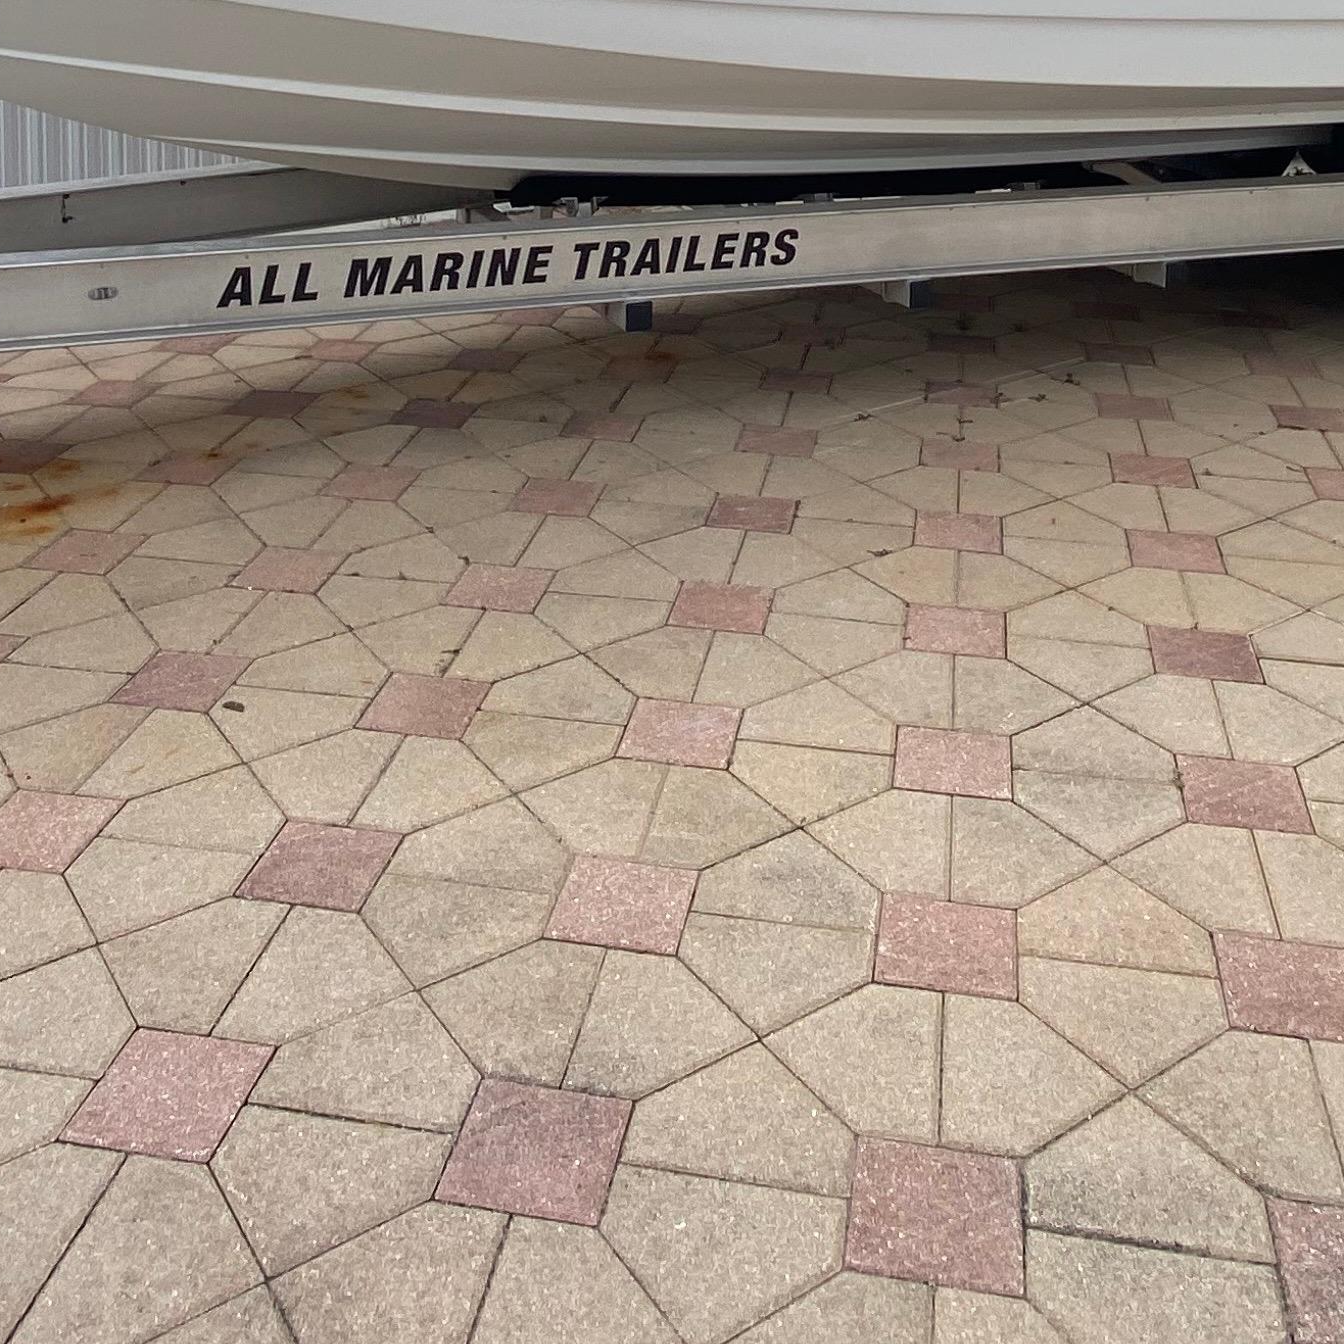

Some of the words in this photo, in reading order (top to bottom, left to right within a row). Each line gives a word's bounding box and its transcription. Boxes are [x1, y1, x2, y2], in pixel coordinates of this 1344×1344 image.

[216, 262, 319, 308] ALL
[343, 245, 554, 299] MARINE
[573, 228, 799, 281] TRAILERS
